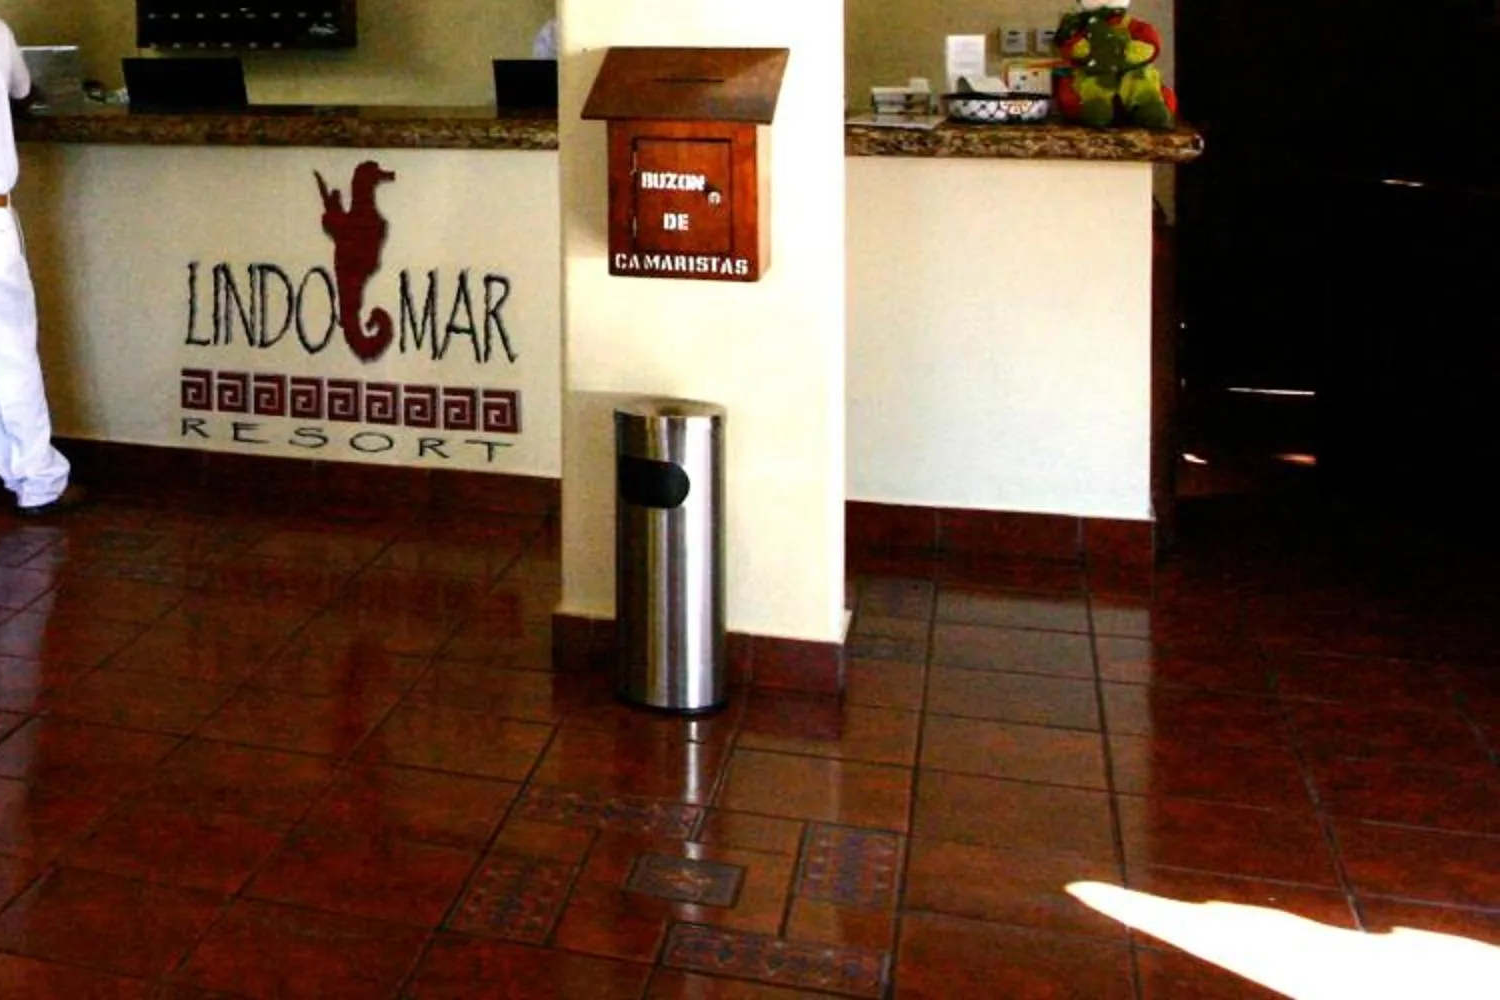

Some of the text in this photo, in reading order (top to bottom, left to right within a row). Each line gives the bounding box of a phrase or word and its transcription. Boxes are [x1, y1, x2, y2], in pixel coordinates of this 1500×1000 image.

[641, 171, 706, 191] BUZON
[662, 212, 690, 231] DE
[614, 253, 750, 276] CAMARISTAS
[184, 260, 520, 364] LINDO MAR
[180, 416, 514, 463] RESORT
